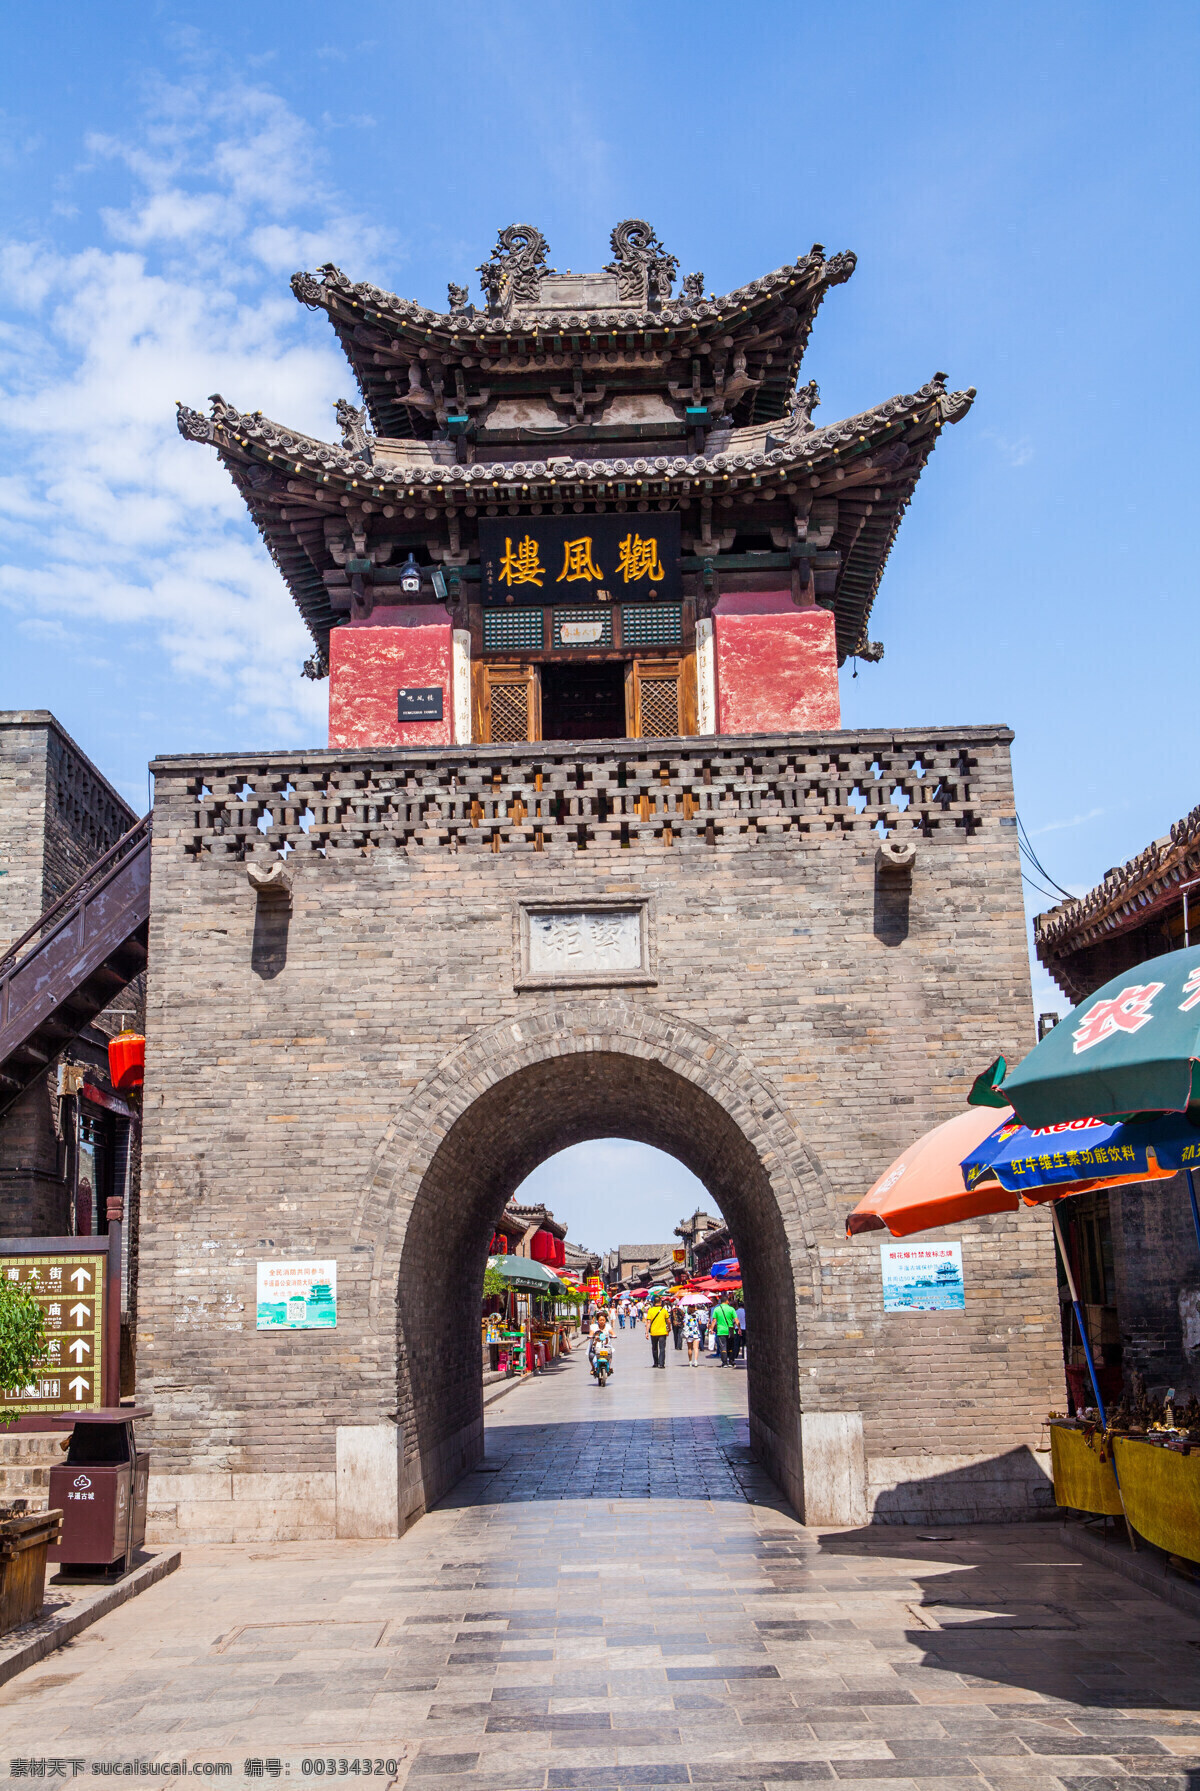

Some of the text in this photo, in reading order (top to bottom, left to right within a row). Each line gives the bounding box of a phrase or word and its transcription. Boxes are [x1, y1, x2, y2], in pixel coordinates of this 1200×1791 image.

[1010, 1144, 1136, 1175] 红牛维生素功能饮料
[7, 1267, 62, 1281] 南大街
[49, 1303, 62, 1316] 庙
[67, 1492, 95, 1500] 平遥古城
